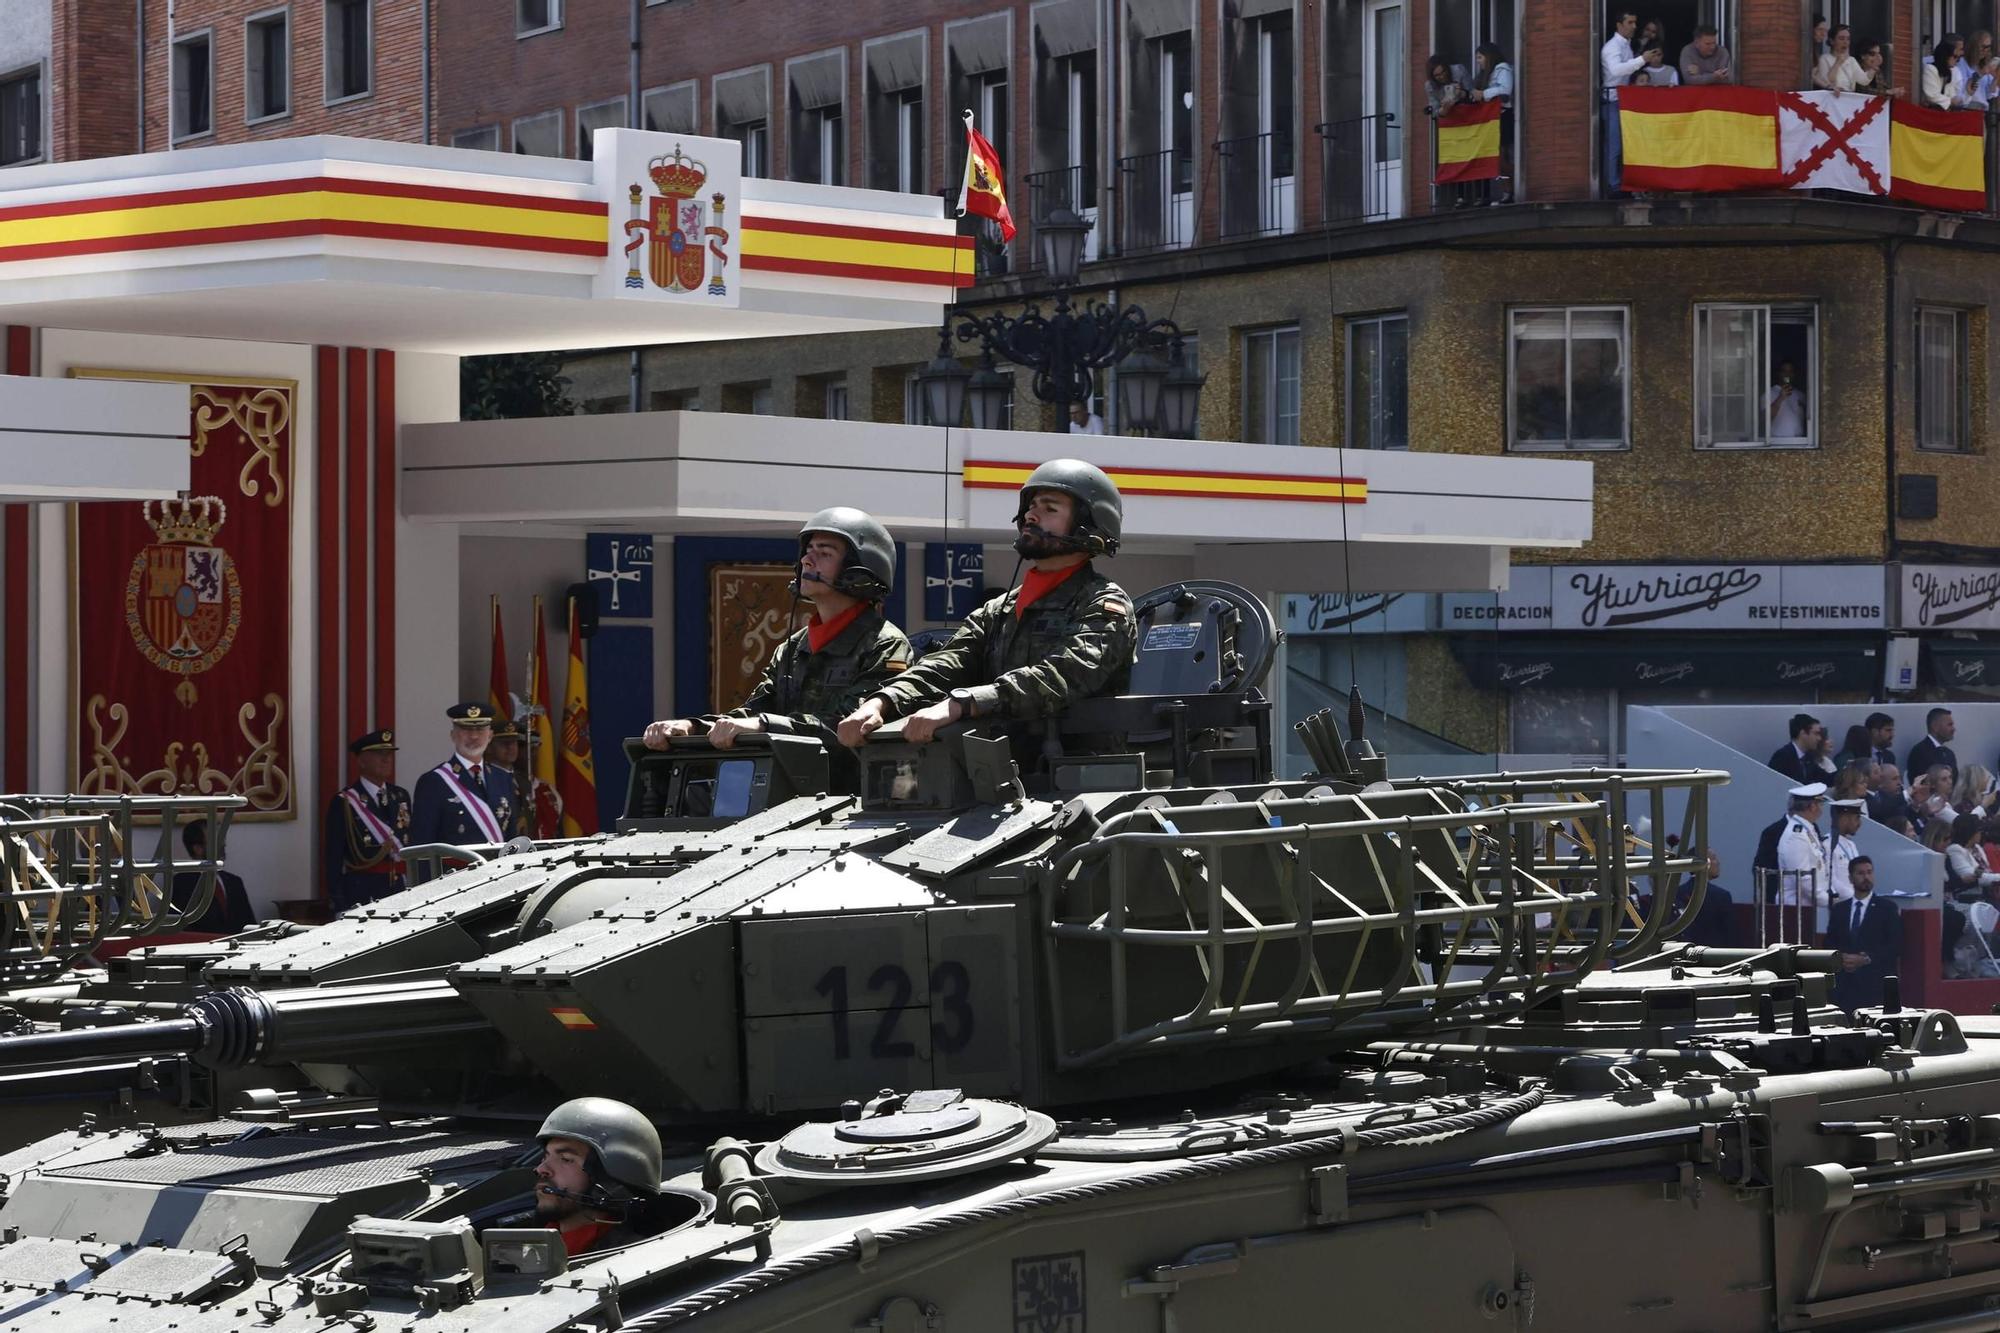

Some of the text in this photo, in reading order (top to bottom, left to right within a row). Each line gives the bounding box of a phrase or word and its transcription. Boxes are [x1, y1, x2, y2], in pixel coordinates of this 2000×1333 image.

[1453, 606, 1552, 620] DECORACION
[1570, 568, 1762, 627] Yturriaga
[1748, 605, 1881, 619] REVESTIMIENTOS
[1912, 572, 2000, 626] Yturriag
[815, 961, 974, 1061] 123
